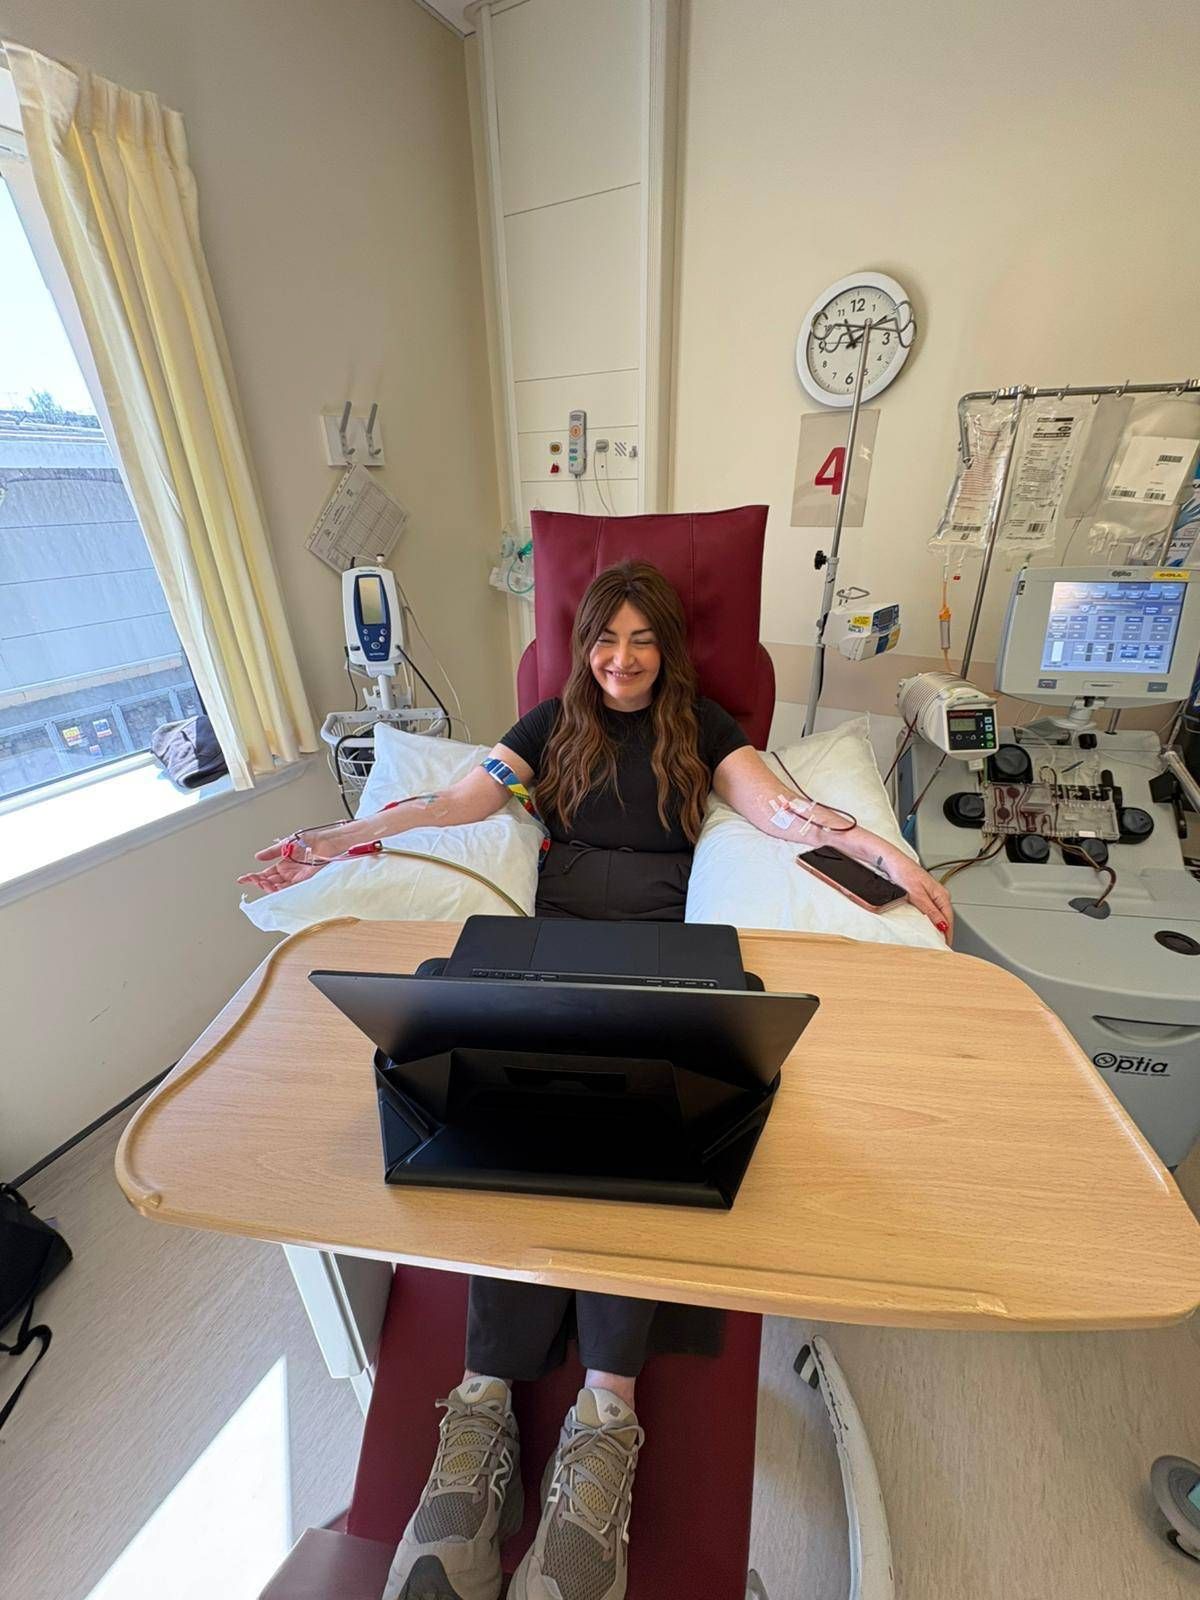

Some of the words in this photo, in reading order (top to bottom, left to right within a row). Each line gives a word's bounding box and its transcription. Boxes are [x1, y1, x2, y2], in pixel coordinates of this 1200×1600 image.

[850, 298, 866, 313] 12
[871, 304, 877, 312] 1
[837, 309, 845, 317] 11
[882, 332, 891, 345] 3
[876, 353, 882, 361] 4
[822, 360, 828, 368] 8
[831, 371, 837, 379] 7
[845, 372, 854, 385] 6
[815, 447, 846, 495] 4
[1093, 1053, 1168, 1073] Optia
